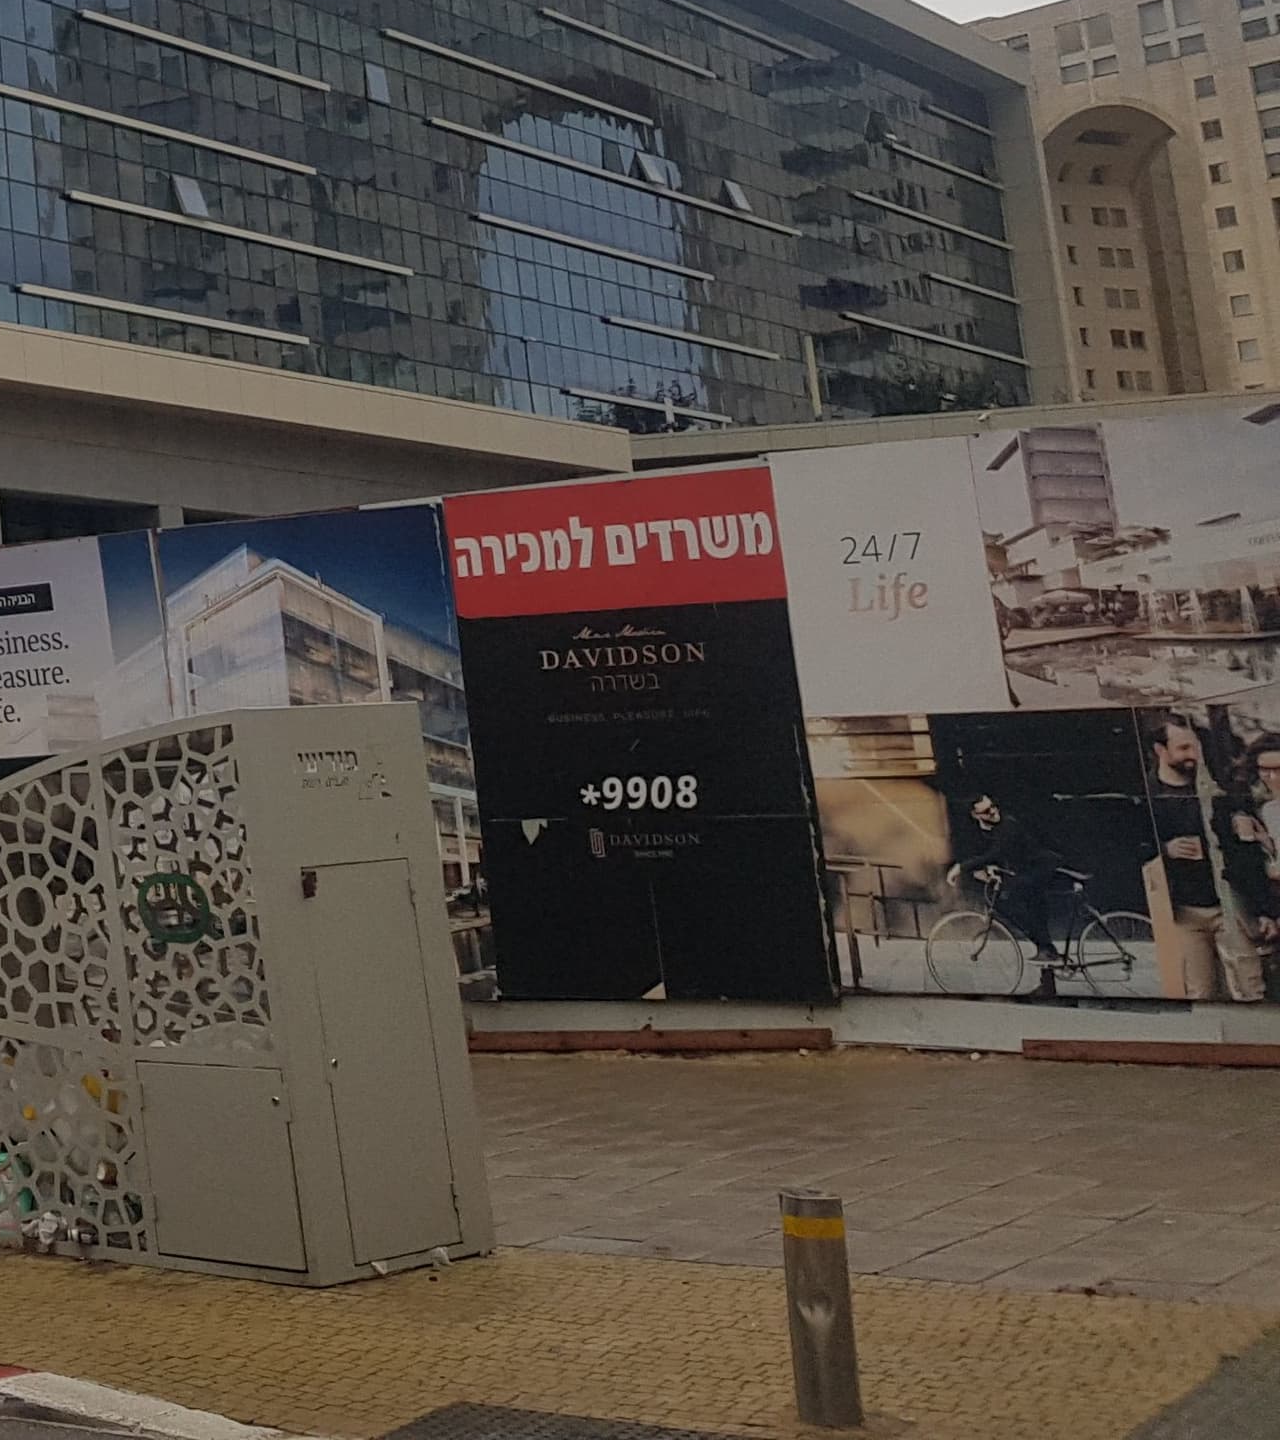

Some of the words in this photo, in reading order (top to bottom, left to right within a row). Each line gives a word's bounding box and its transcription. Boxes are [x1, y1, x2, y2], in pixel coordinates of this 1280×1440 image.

[454, 516, 594, 578] למכירה
[604, 511, 774, 567] משרדים
[840, 532, 921, 565] 24/7
[7, 593, 36, 607] הבניה
[848, 572, 928, 621] Life
[539, 642, 707, 670] DAVIDSON
[591, 672, 661, 692] בשדרה
[609, 833, 702, 847] DAVIDSON
